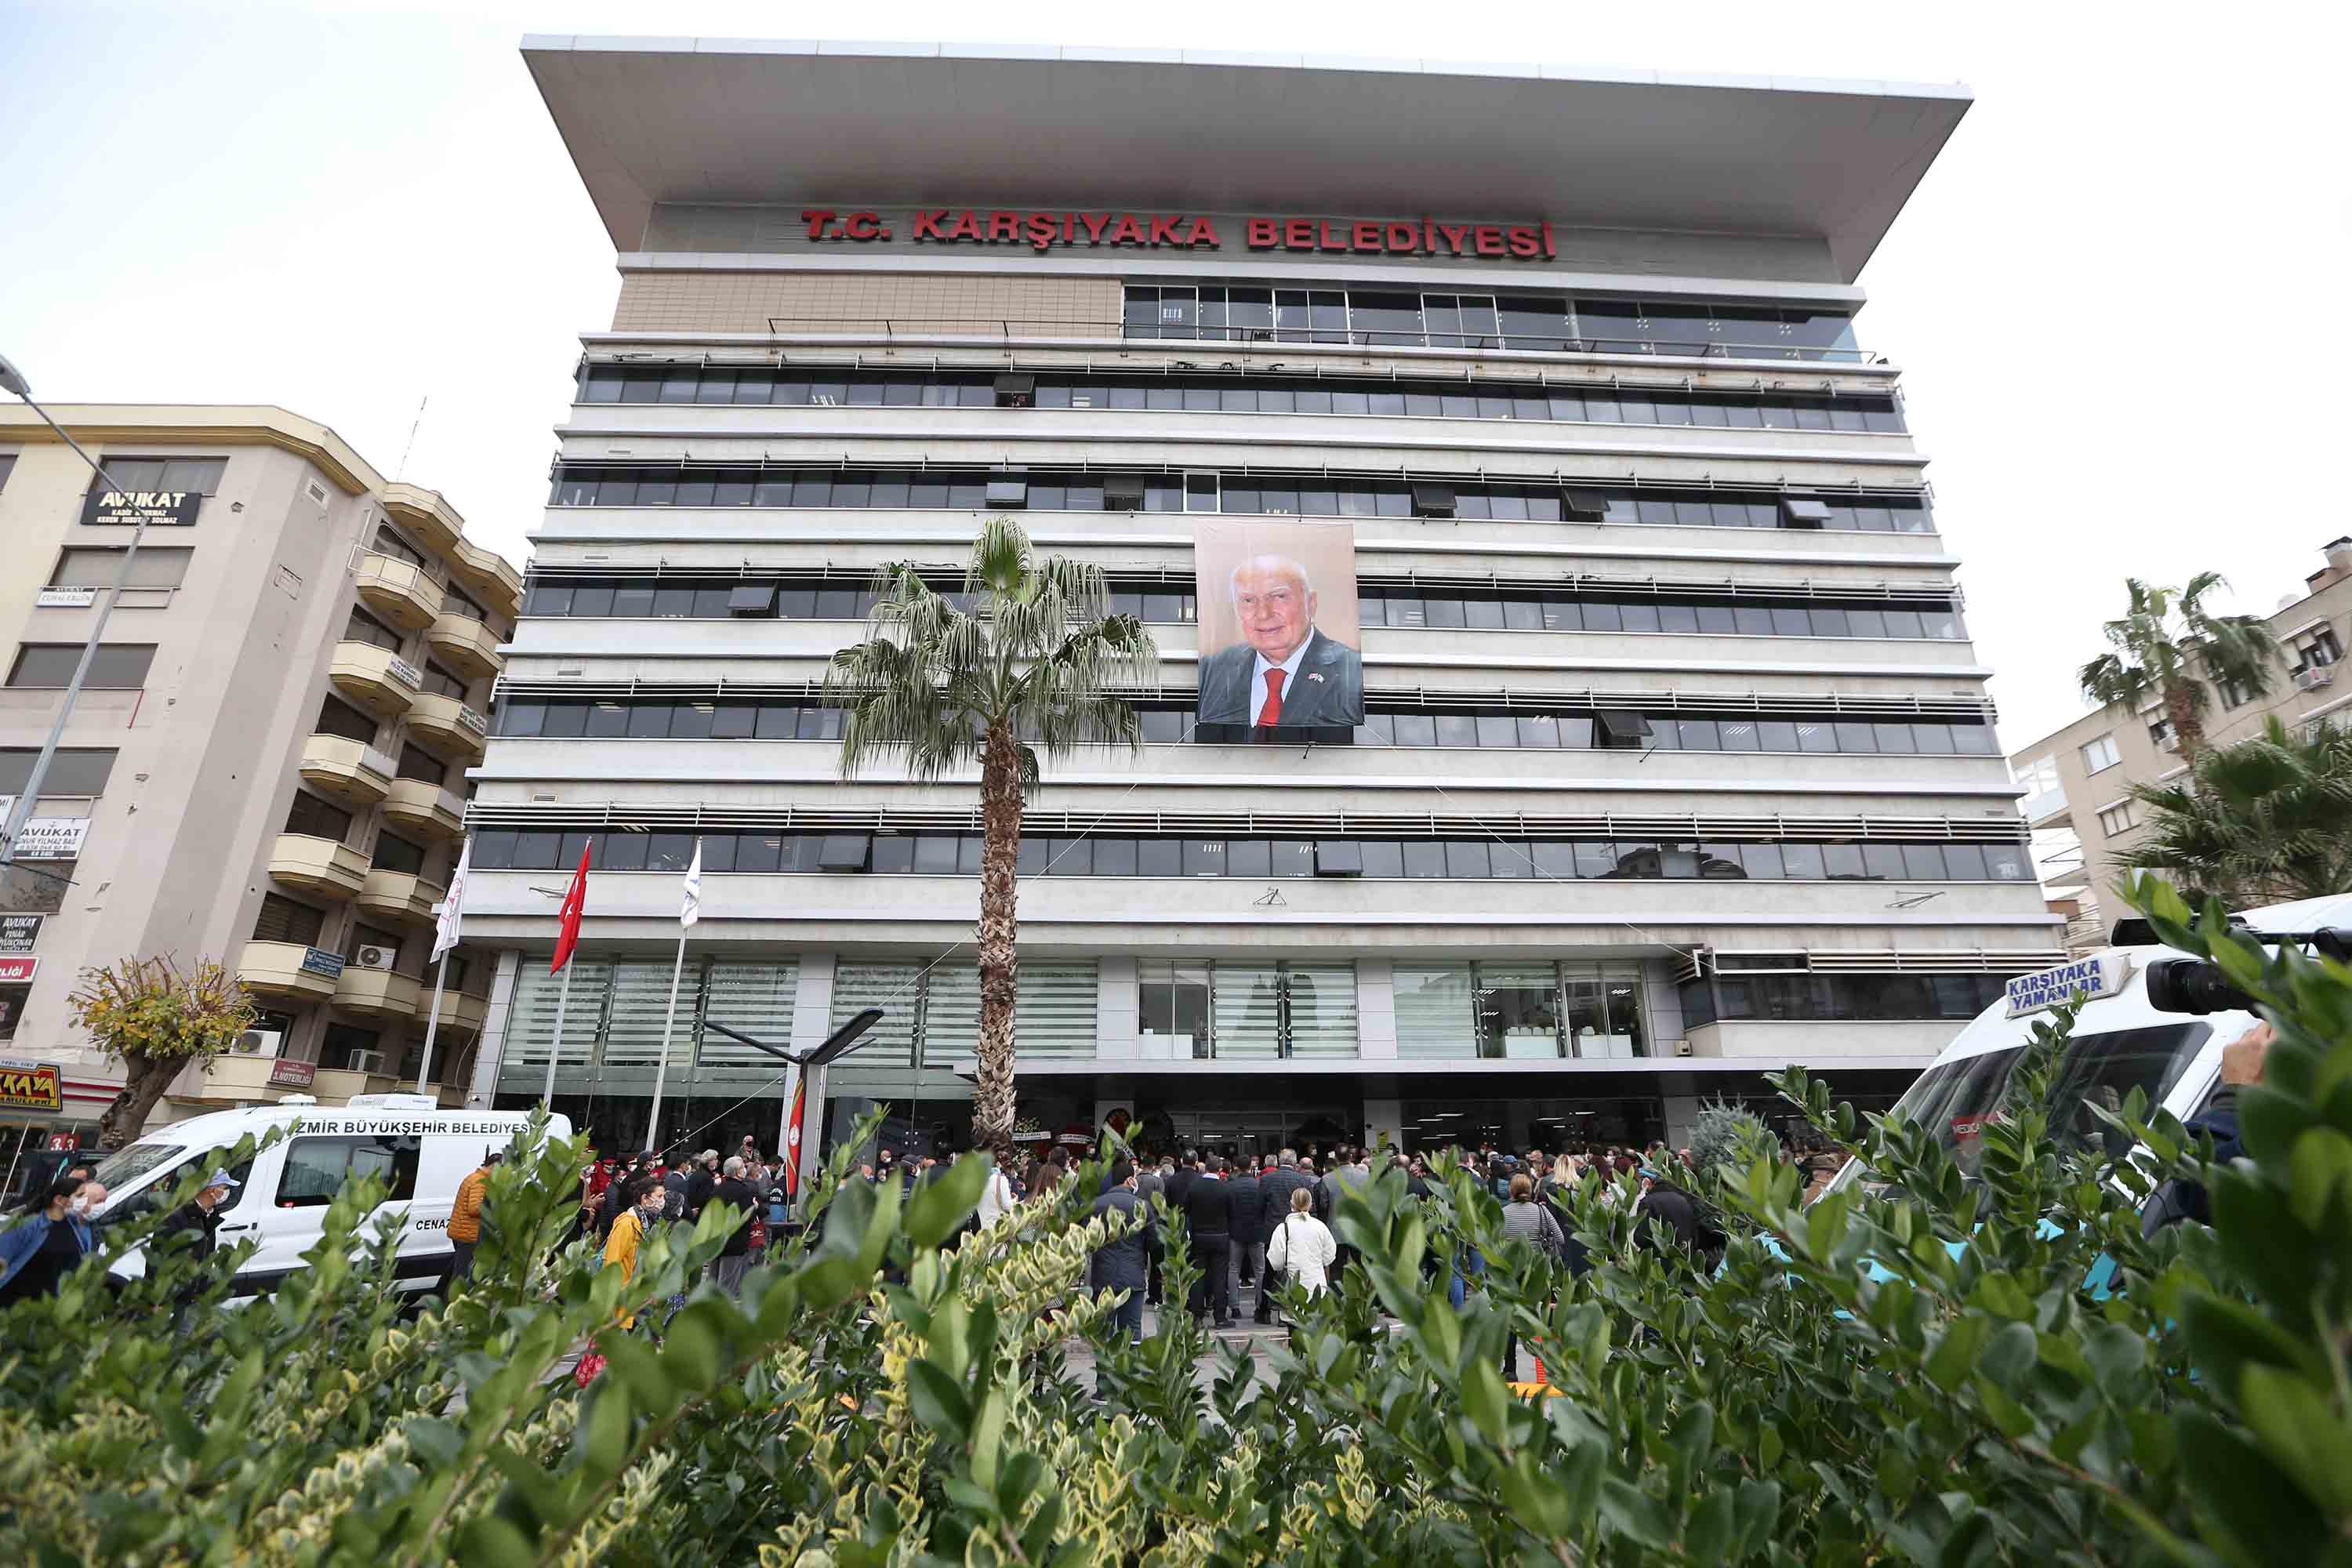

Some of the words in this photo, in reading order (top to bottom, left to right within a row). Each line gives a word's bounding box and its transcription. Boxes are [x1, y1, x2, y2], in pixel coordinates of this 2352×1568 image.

[801, 209, 891, 241] T.C.
[912, 209, 1221, 252] KARŞIYAKA
[1247, 216, 1556, 260] BELEDİYESİ
[99, 491, 186, 508] AVUKAT
[20, 827, 82, 837] AVUKAT
[2, 916, 38, 928] AVUKAT
[2009, 959, 2101, 996] KARŞIYAKA
[294, 1118, 339, 1134] ZMİR
[343, 1118, 447, 1136] BÜYÜKŞEHİR
[452, 1120, 530, 1134] BELEDİYES
